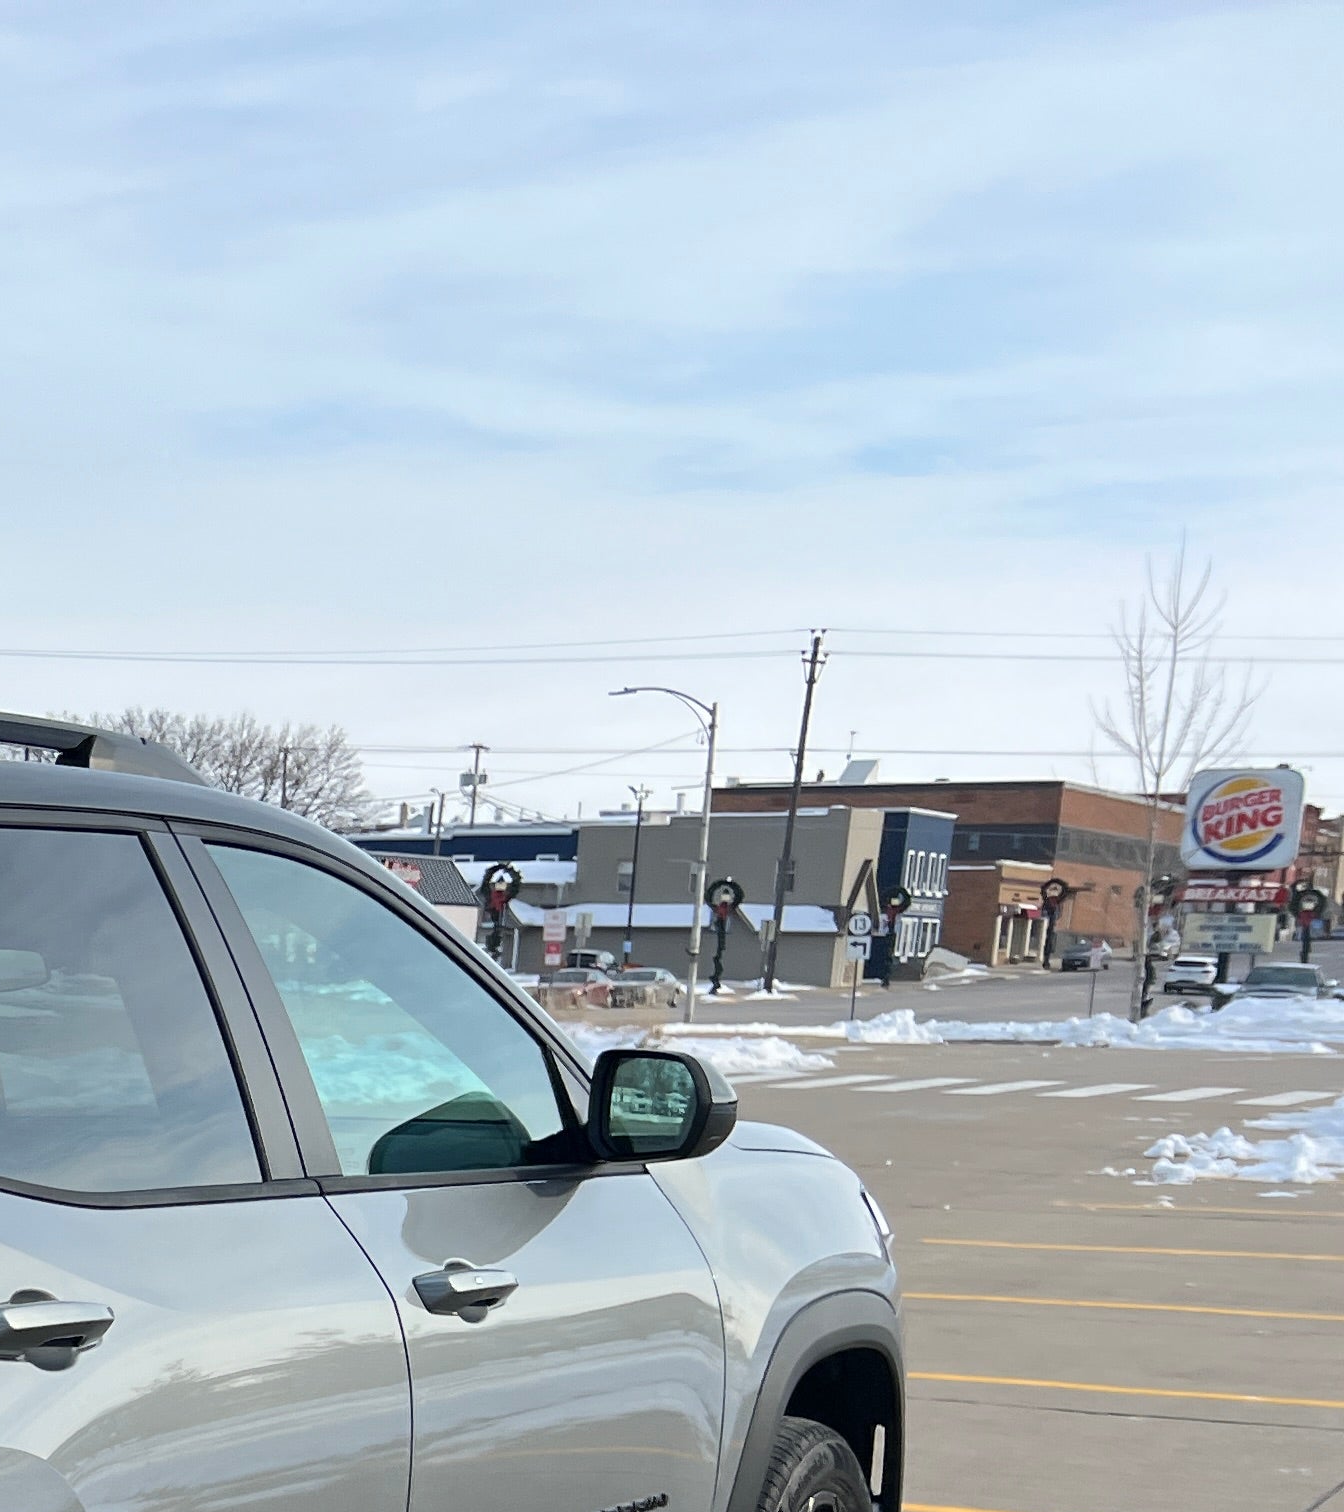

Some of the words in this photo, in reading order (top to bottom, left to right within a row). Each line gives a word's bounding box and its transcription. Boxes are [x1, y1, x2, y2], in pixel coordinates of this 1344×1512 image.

[1202, 789, 1282, 823] BURGER
[1202, 806, 1283, 846] KING
[1184, 887, 1276, 901] BREAKFAST
[854, 917, 867, 931] 13
